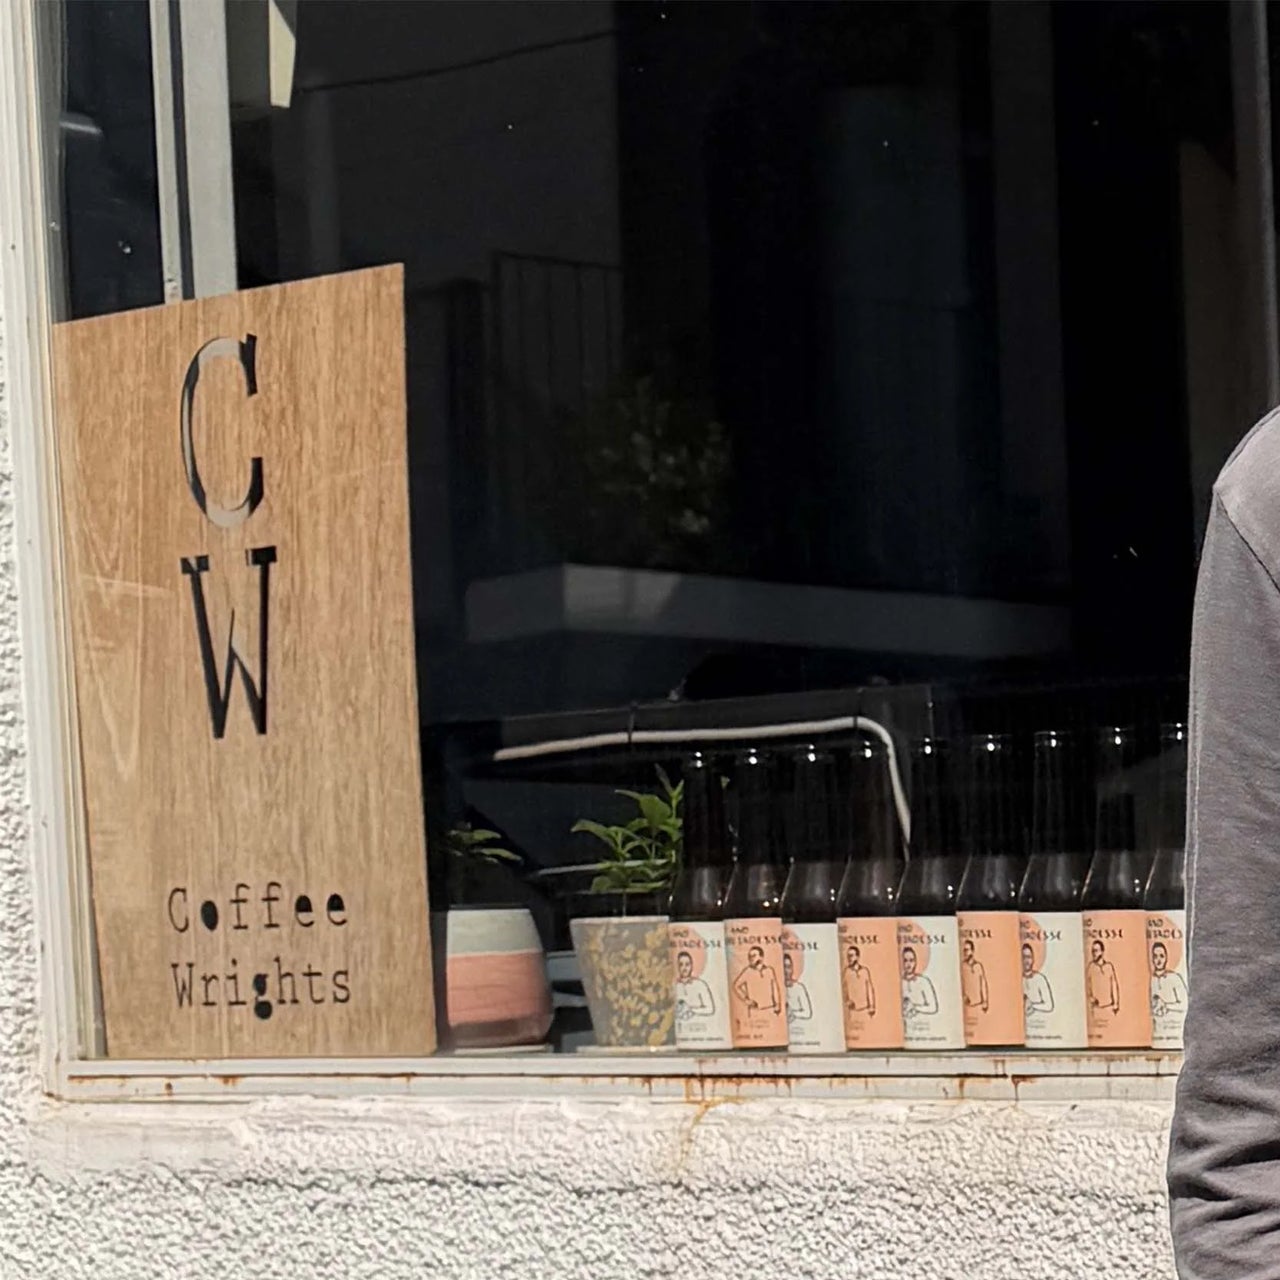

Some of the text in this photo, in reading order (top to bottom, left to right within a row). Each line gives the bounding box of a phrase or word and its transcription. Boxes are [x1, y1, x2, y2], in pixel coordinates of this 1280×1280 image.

[180, 333, 264, 528] C
[180, 545, 277, 739] W
[168, 881, 348, 933] Coffee
[171, 956, 350, 1020] Wrights
